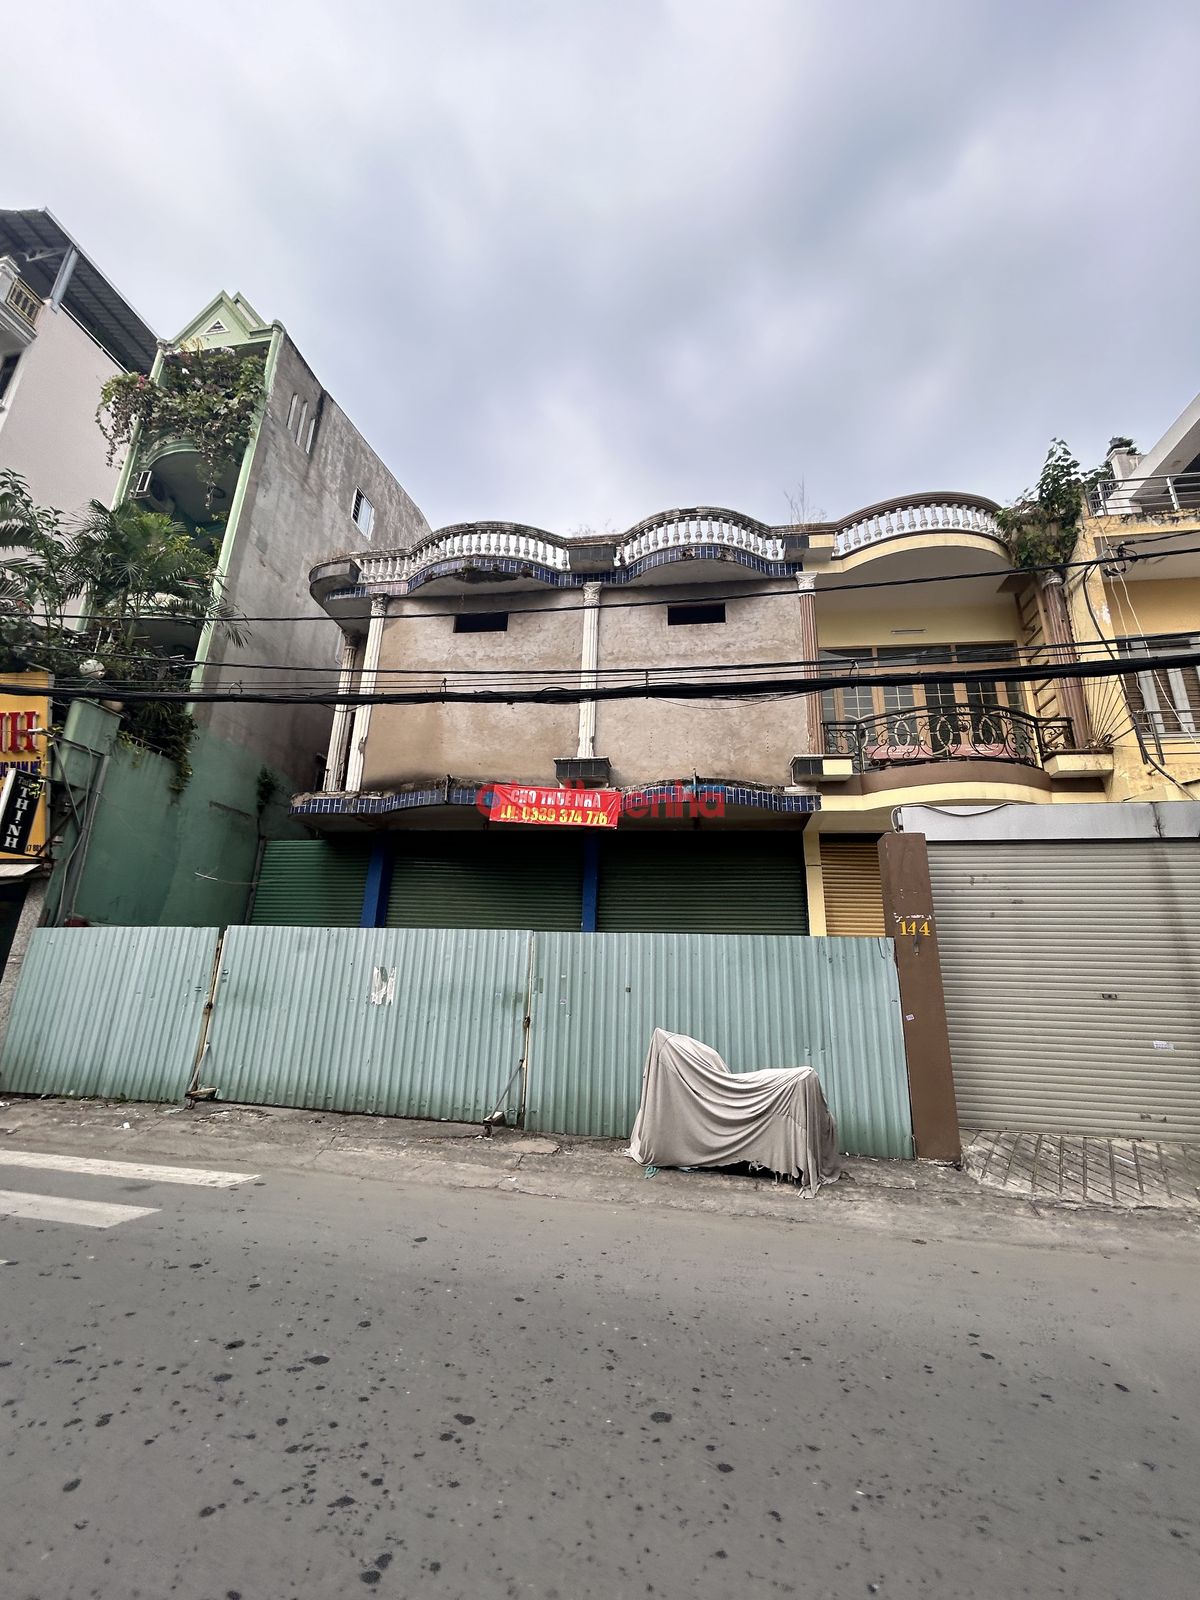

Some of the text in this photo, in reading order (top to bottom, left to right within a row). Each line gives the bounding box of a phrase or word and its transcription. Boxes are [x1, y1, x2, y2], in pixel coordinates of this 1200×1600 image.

[510, 789, 602, 808] CHO THUÊ NHÀ
[4, 786, 30, 850] THỊNH
[558, 809, 584, 824] 374
[900, 920, 931, 936] 144
